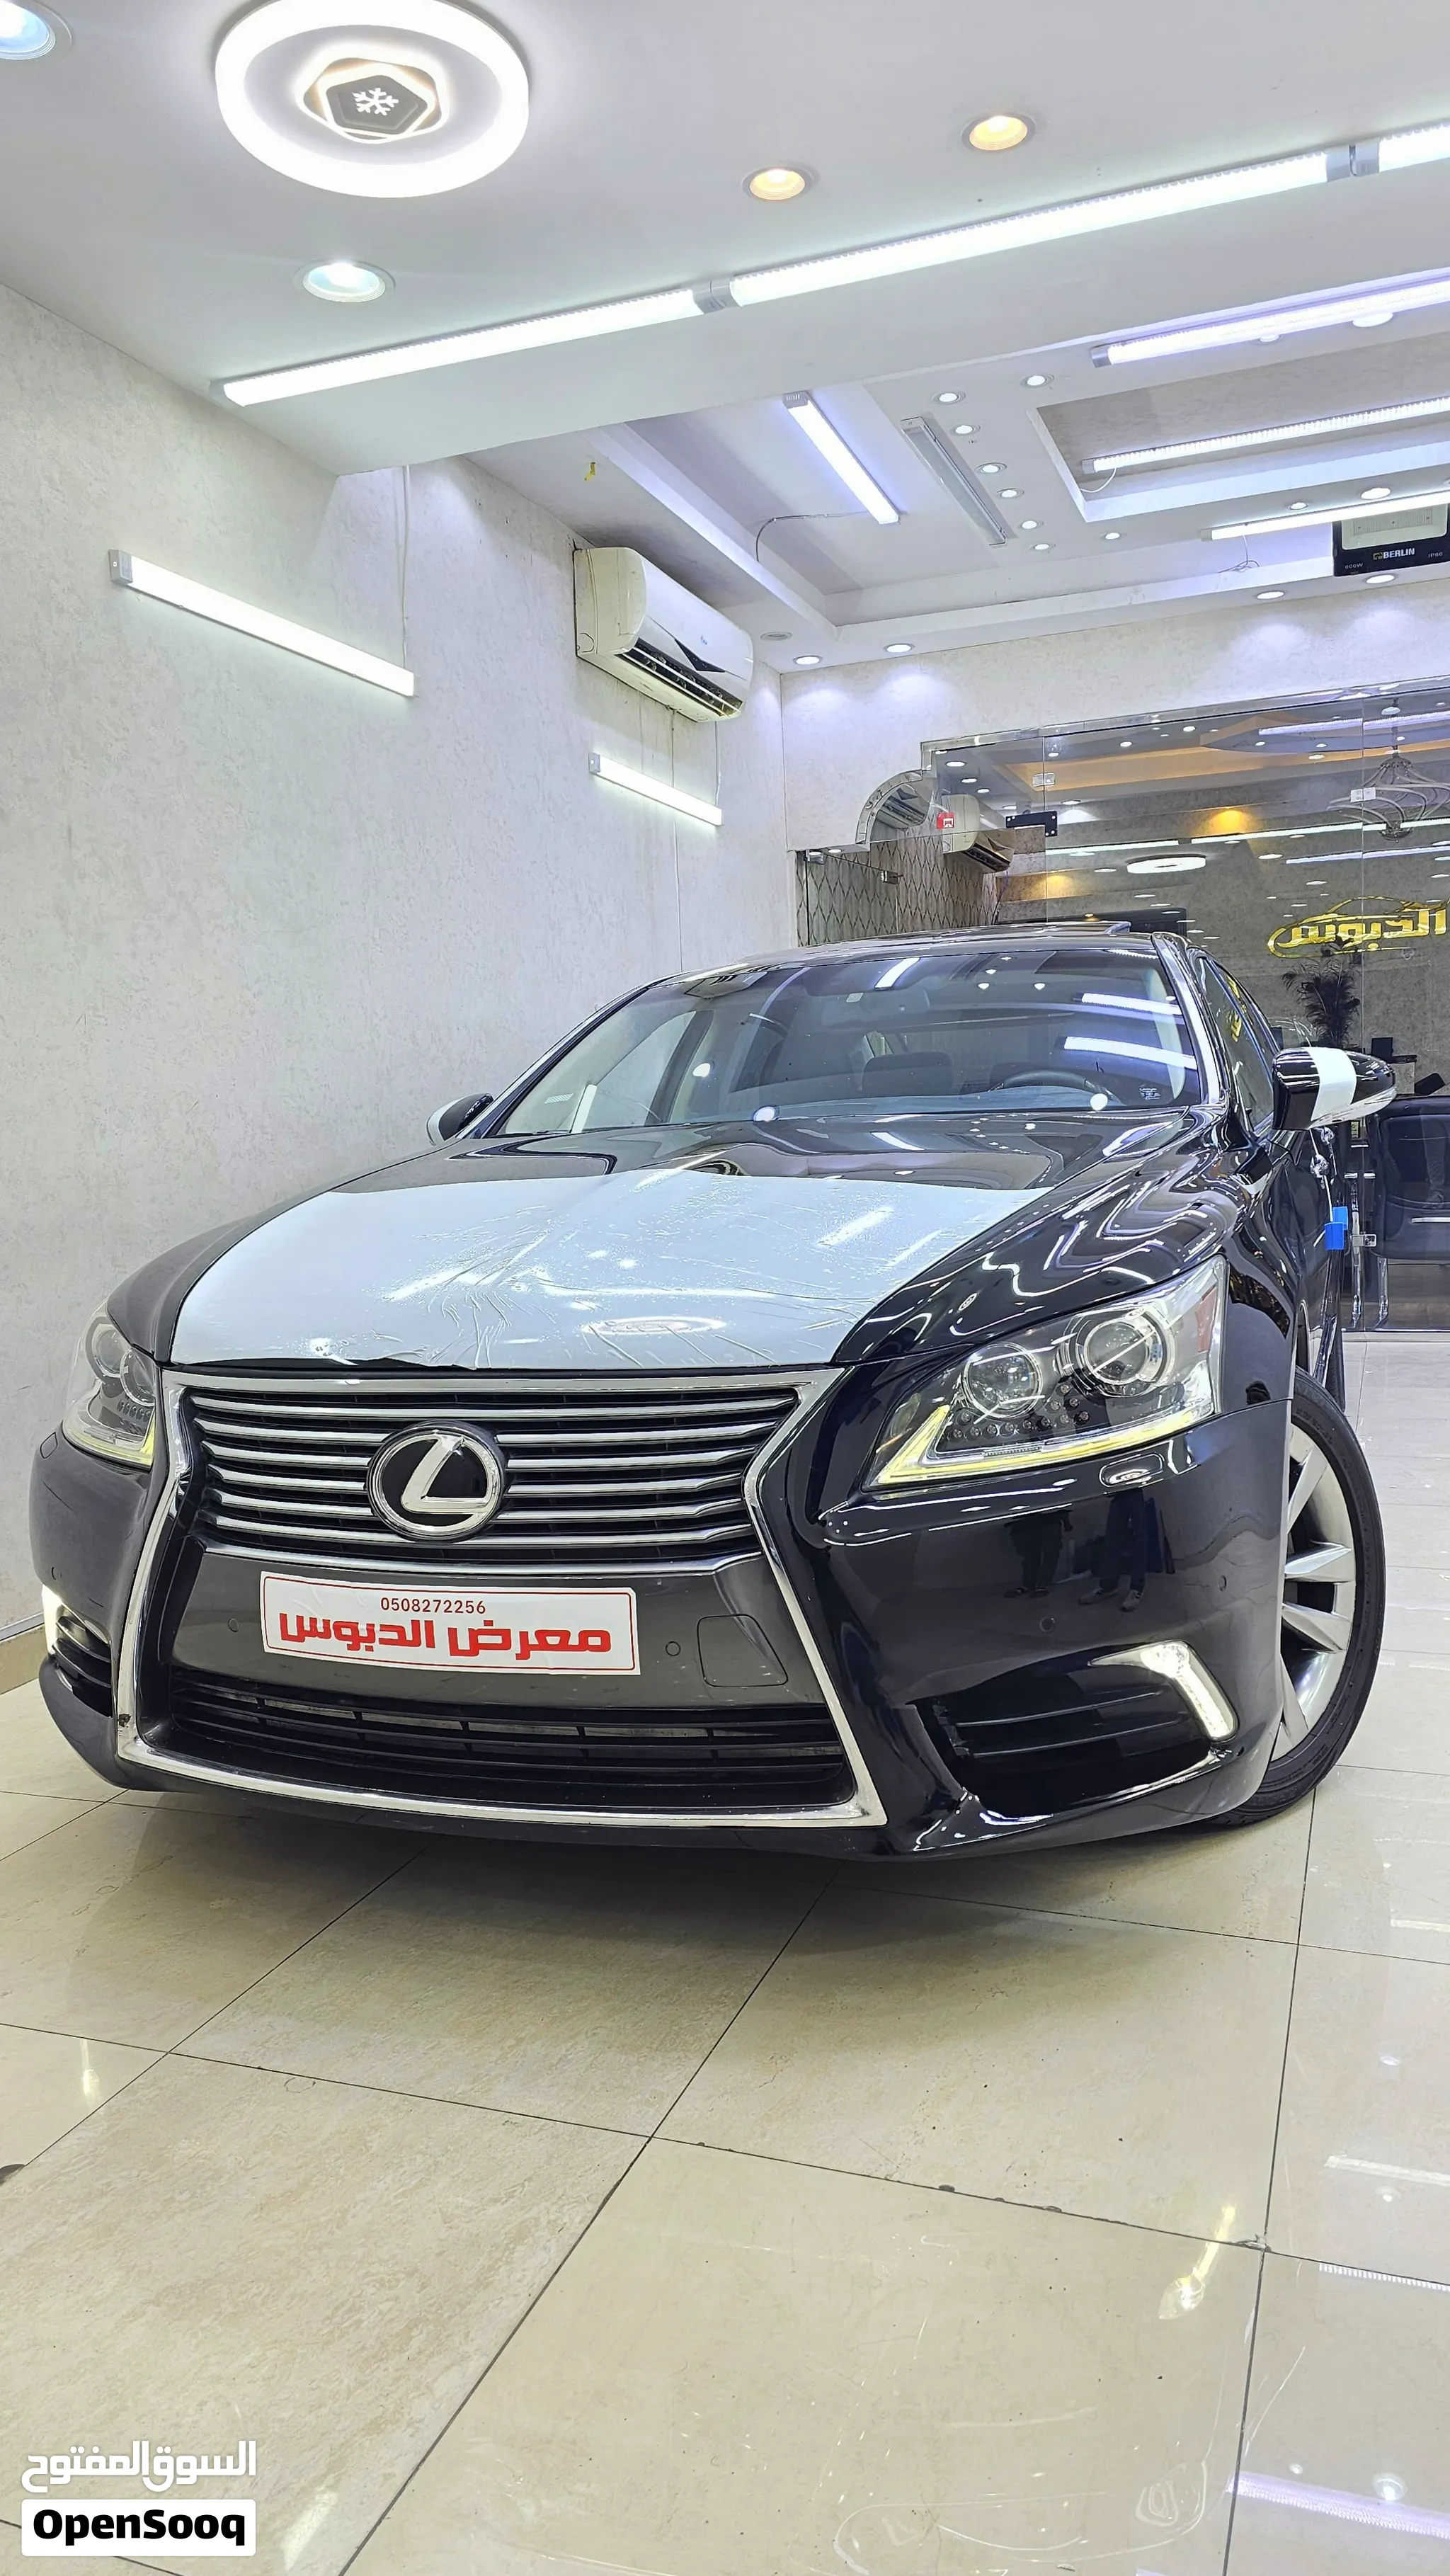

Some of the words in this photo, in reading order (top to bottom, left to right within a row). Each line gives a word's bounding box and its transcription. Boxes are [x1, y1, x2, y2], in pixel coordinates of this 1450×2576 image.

[1383, 547, 1415, 559] BERLIN
[380, 1597, 486, 1614] 0508272256
[280, 1612, 435, 1652] الدبوس
[447, 1619, 611, 1660] معرض
